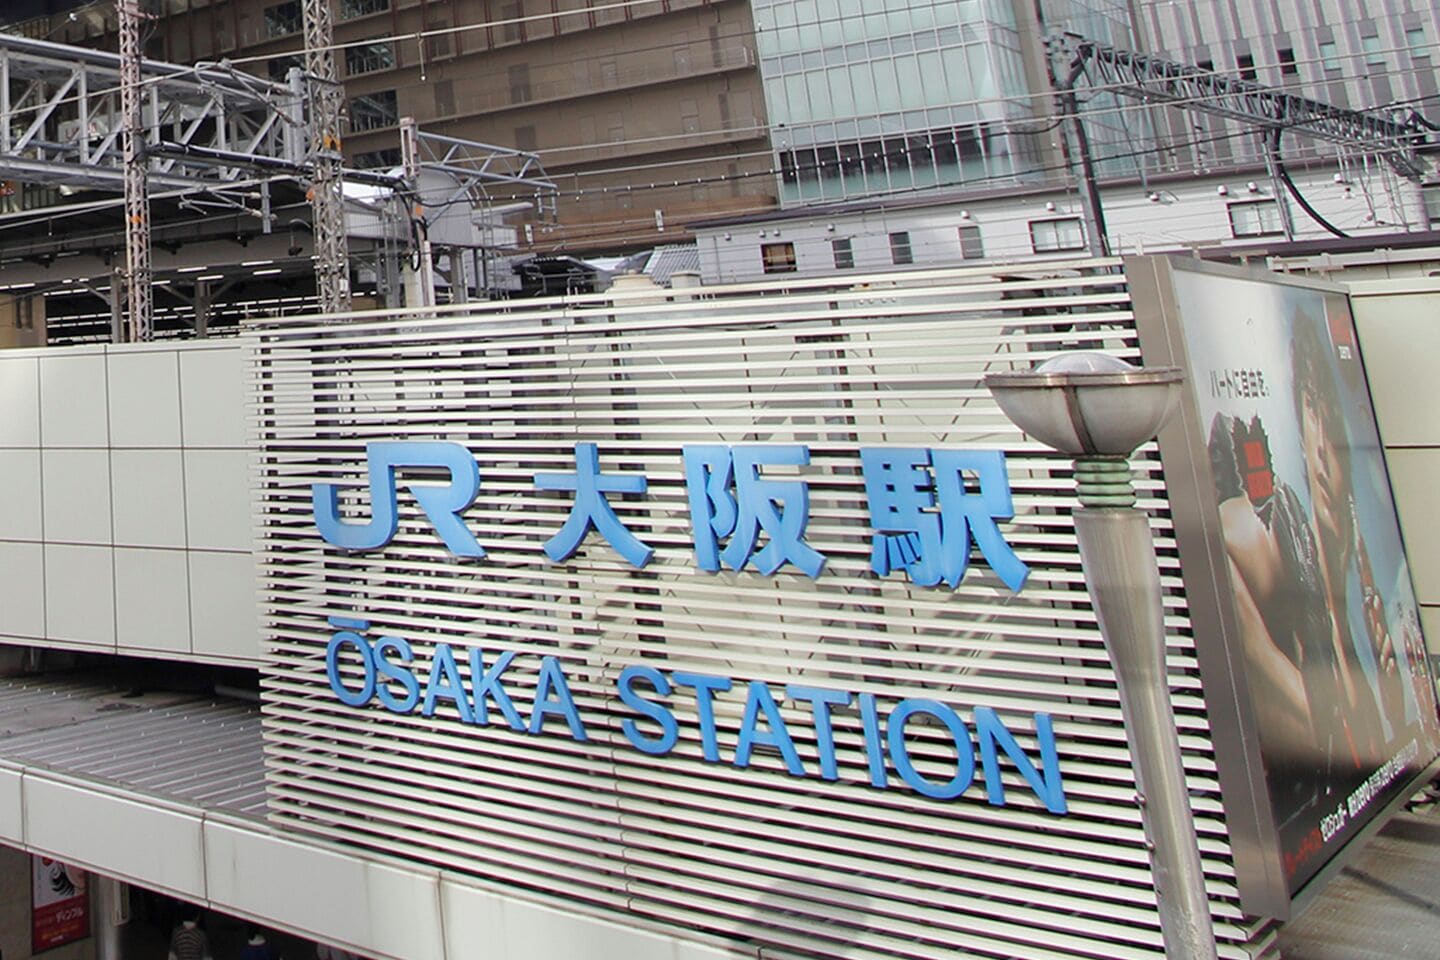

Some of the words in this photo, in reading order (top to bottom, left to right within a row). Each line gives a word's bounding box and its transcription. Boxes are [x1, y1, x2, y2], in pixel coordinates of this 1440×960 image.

[311, 440, 487, 558] JR
[533, 441, 1031, 595] 大阪駅
[617, 664, 1068, 815] STATION
